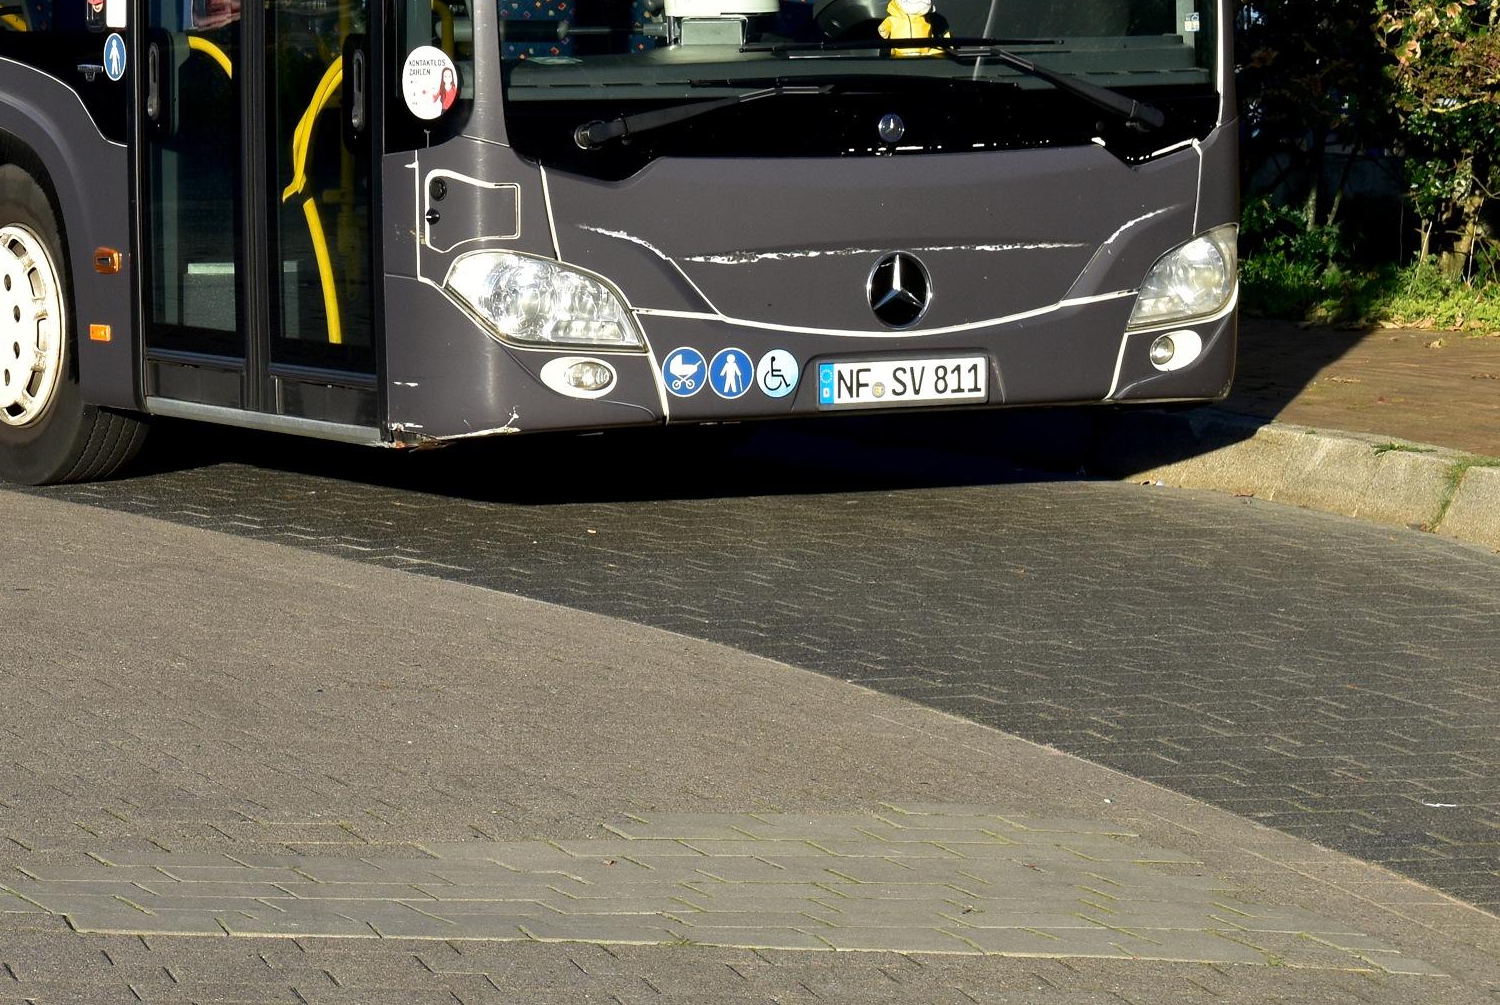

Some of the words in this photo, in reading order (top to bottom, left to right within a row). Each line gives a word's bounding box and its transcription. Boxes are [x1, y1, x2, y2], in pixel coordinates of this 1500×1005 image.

[409, 59, 446, 67] KONTAKTLOS
[837, 368, 871, 398] NF
[891, 366, 925, 396] SV
[934, 363, 982, 394] 811
